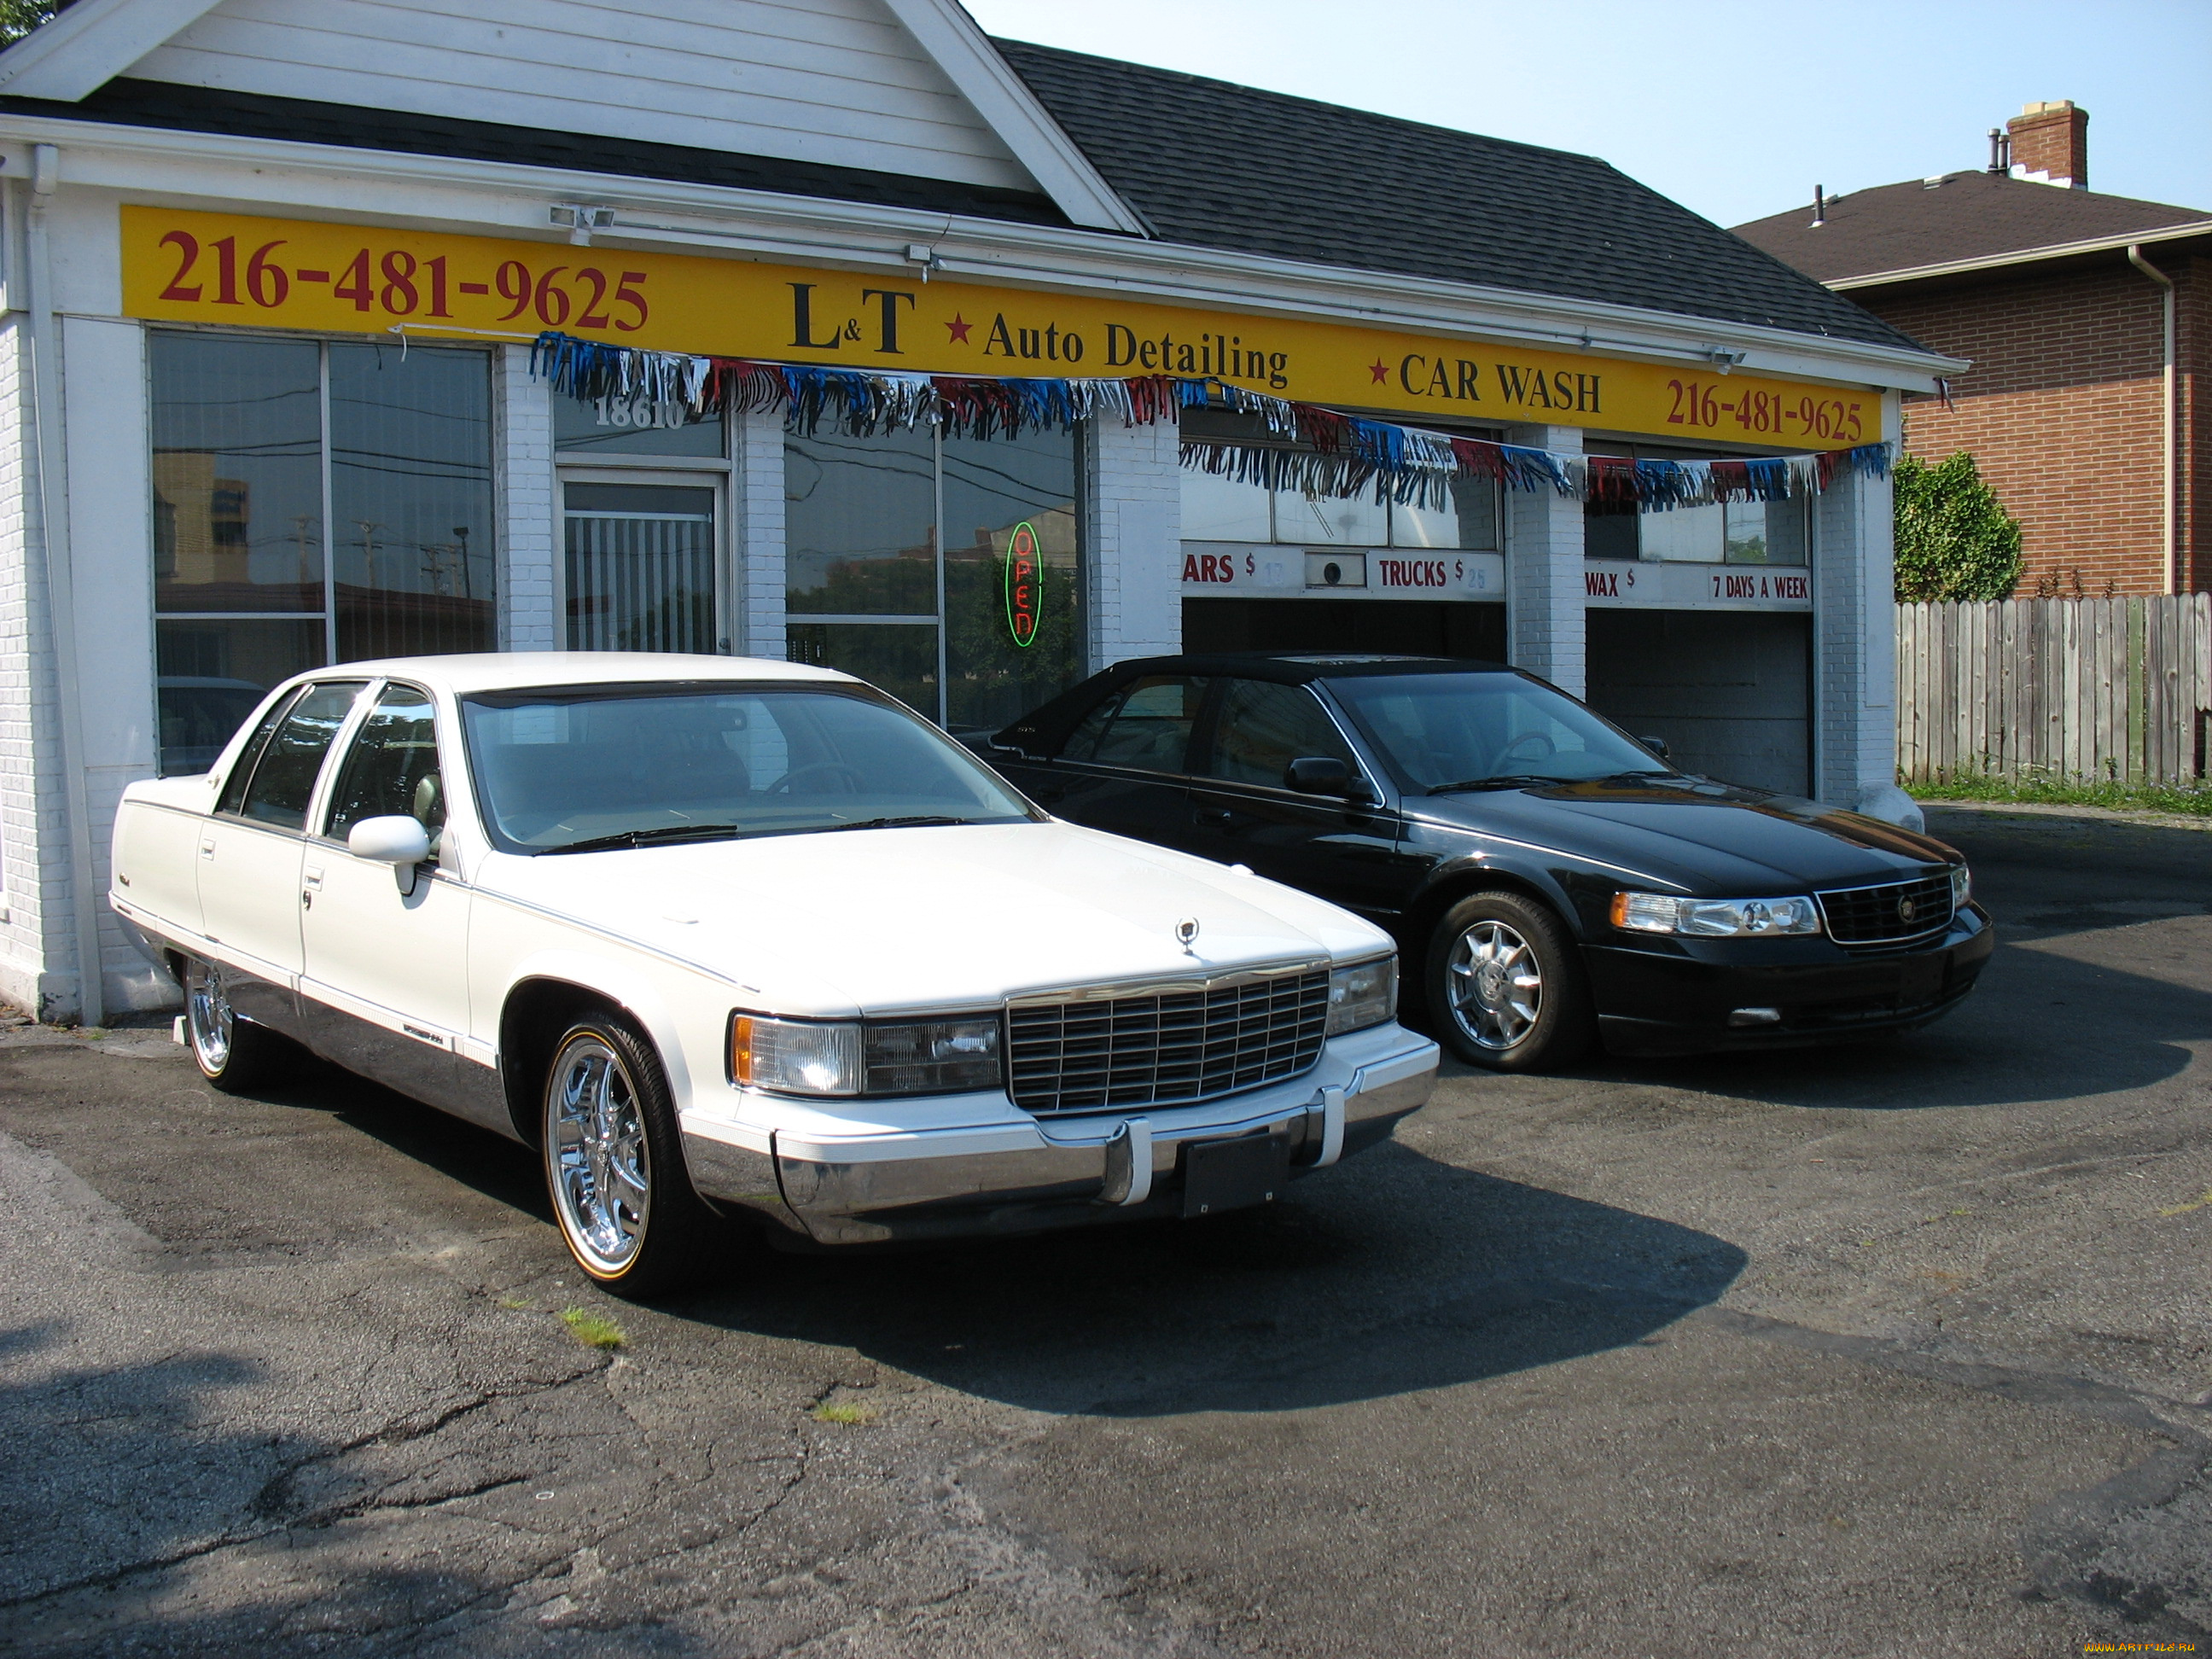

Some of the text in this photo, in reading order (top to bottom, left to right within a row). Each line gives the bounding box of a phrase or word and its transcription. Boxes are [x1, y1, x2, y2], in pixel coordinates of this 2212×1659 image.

[158, 230, 649, 331] 216-481-9625
[982, 312, 1084, 364] Auto
[1103, 323, 1289, 389] Detailing
[1400, 353, 1603, 414] CAR WASH
[596, 394, 684, 429] 18610
[1667, 379, 1863, 442] 216-481-9625
[1016, 531, 1033, 634] OPEN
[1183, 553, 1234, 584] ARS
[1245, 552, 1256, 577] $
[1379, 559, 1447, 587] TRUCKS
[1455, 559, 1464, 581] $
[1585, 568, 1635, 597] WAX $
[1713, 576, 1807, 598] 7 DAYS A WEEK
